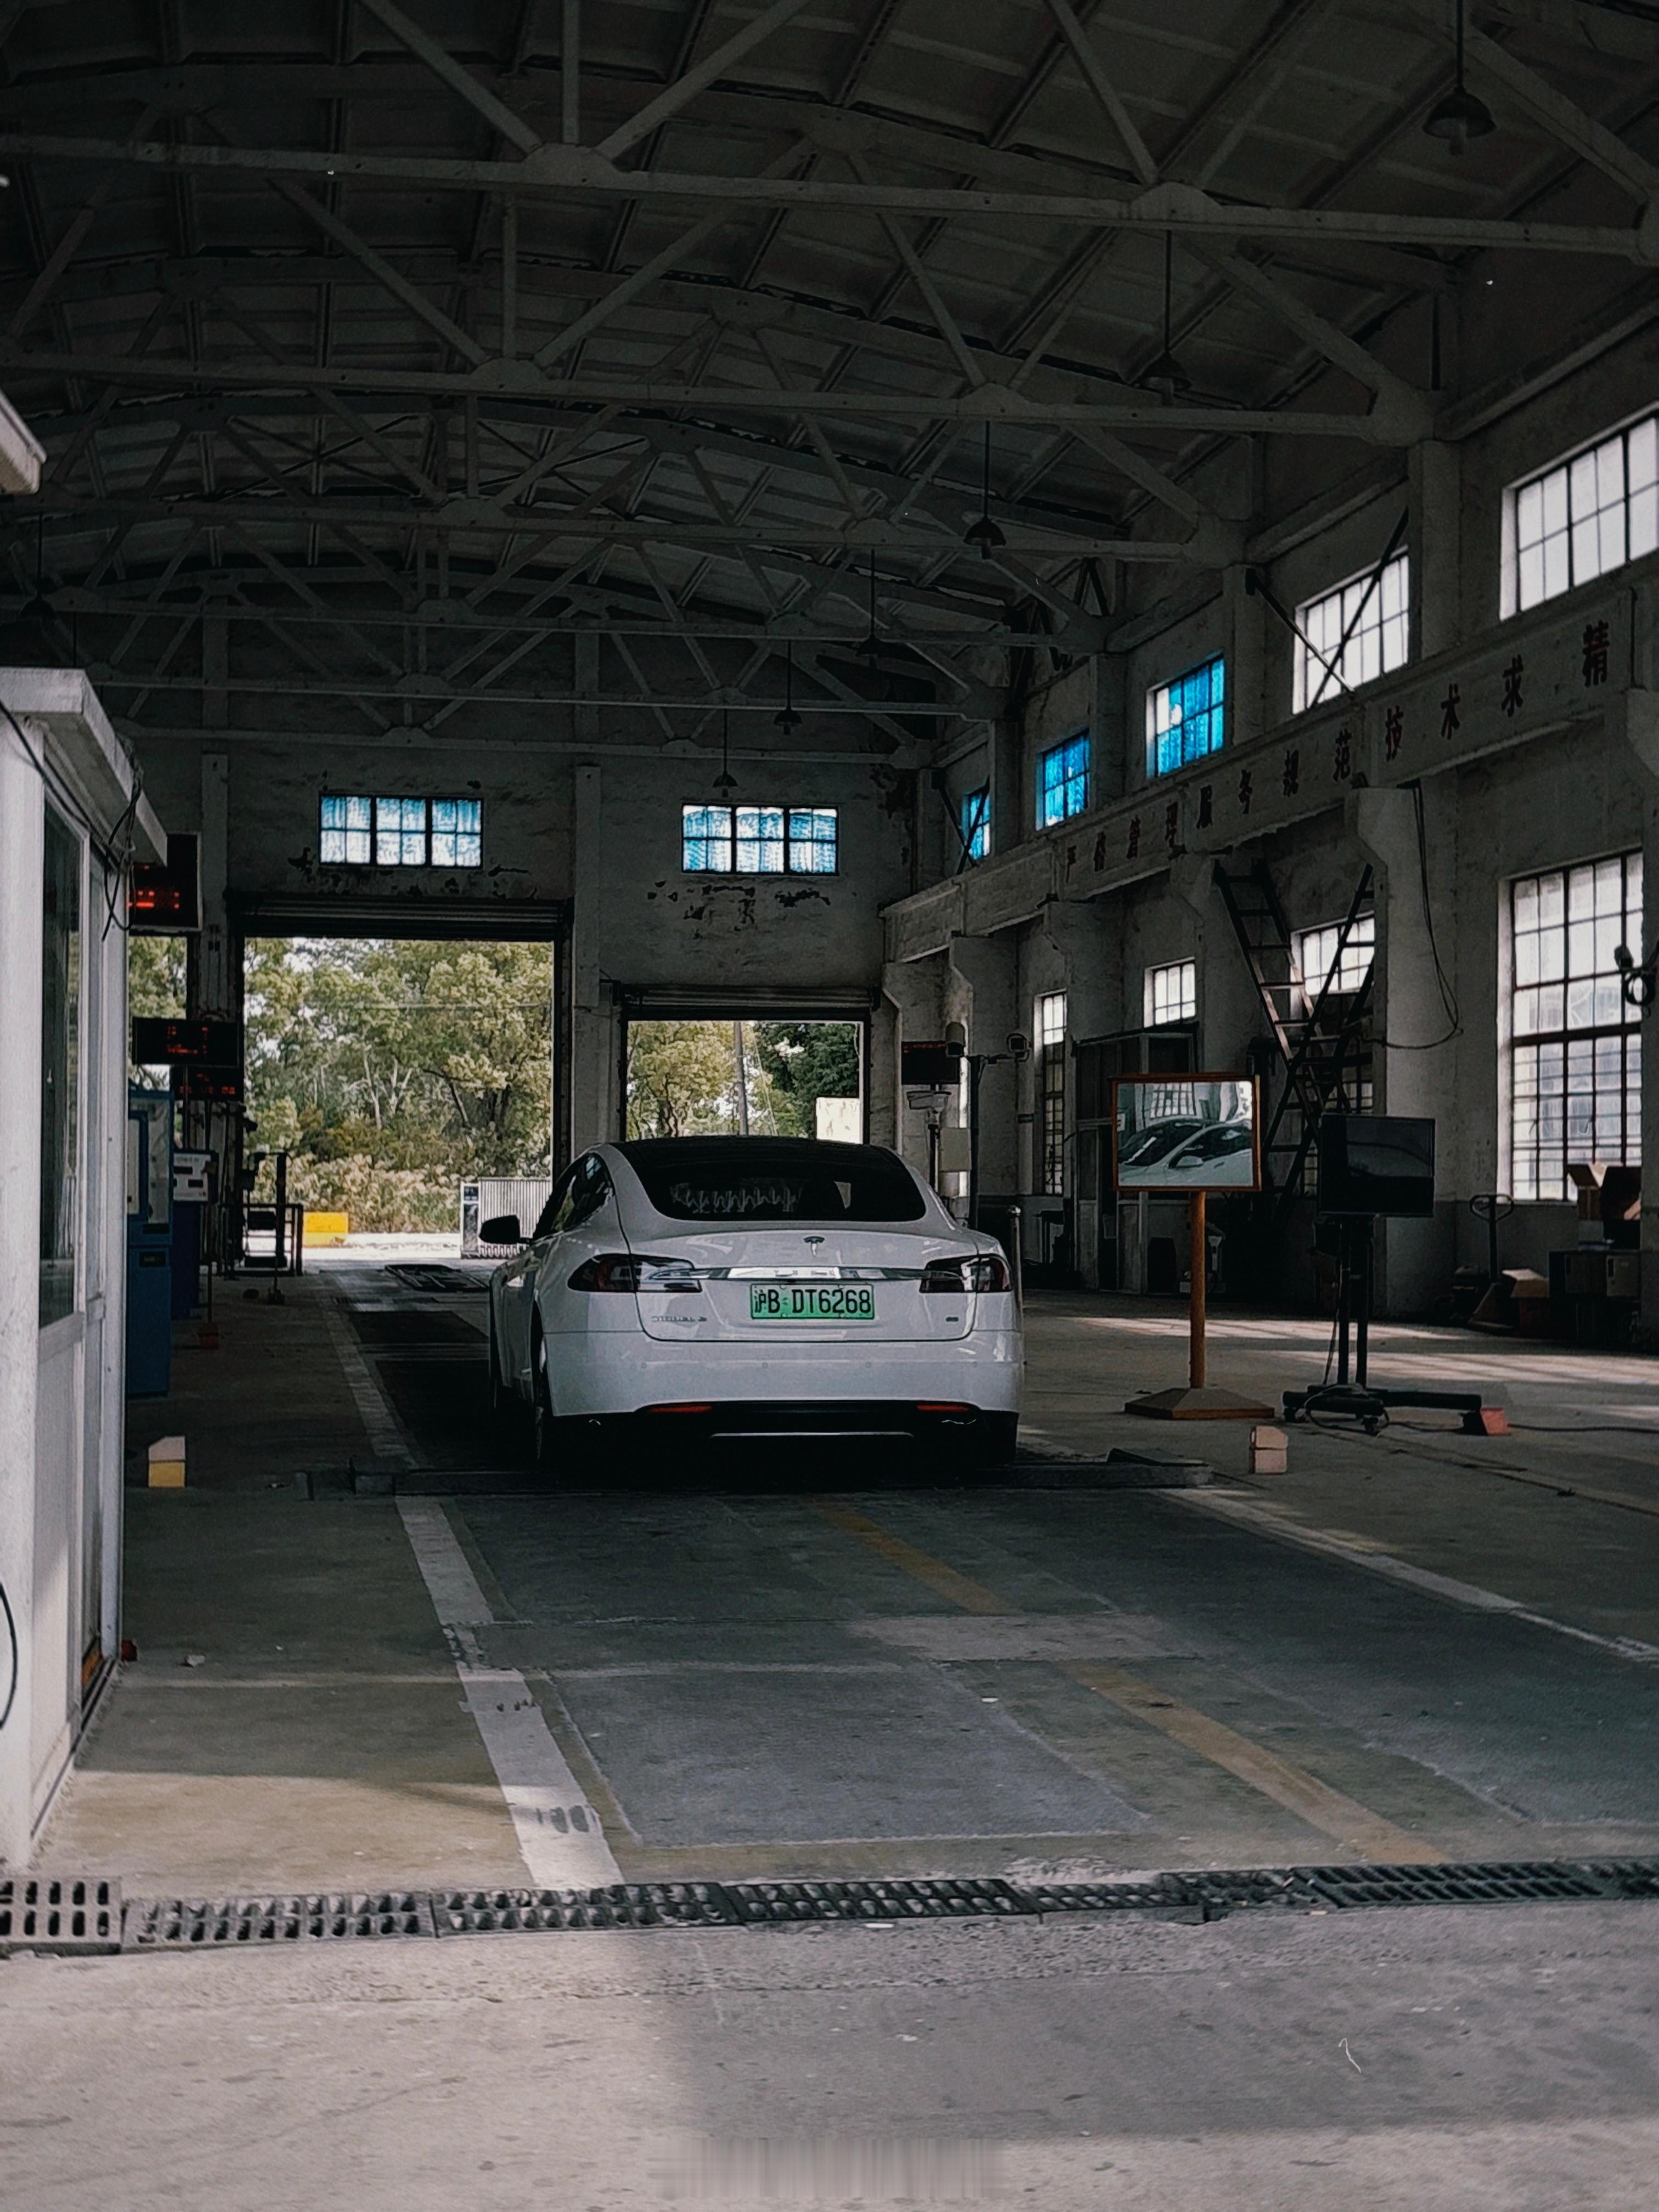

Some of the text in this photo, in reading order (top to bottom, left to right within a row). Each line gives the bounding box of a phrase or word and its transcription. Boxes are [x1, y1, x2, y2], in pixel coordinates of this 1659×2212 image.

[1385, 620, 1610, 762] 技术求精
[792, 1288, 871, 1314] DT6268
